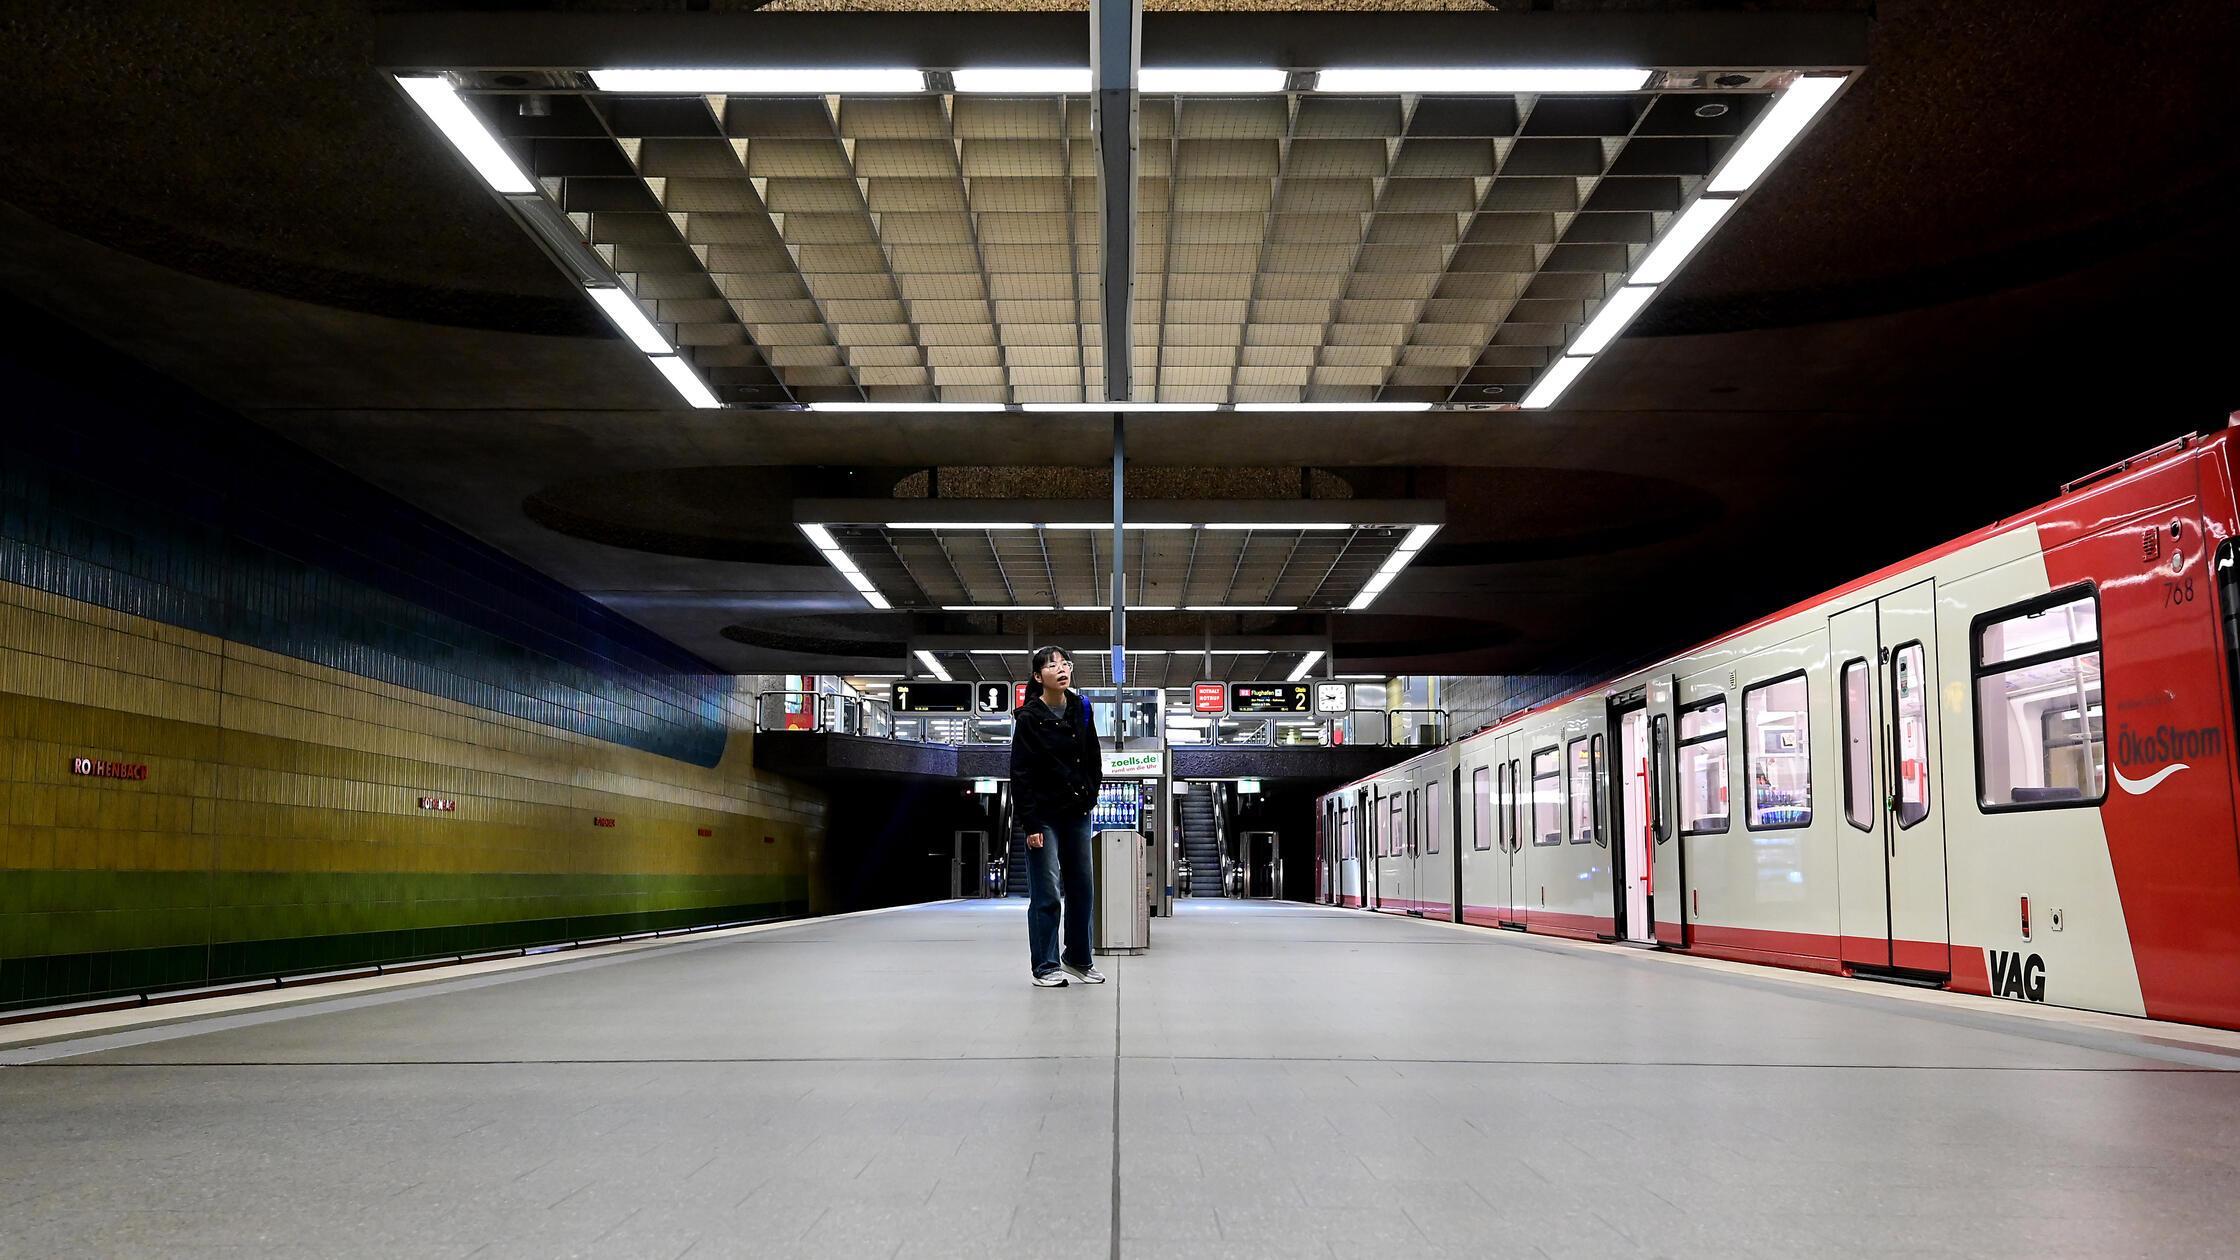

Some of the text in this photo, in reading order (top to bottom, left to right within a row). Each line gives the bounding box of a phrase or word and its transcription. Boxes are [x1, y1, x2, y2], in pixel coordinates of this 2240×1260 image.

[2164, 578, 2194, 608] 768
[898, 692, 906, 710] 1
[1250, 688, 1275, 697] Flughafen
[1295, 693, 1306, 710] 2
[2117, 724, 2222, 767] ÖkoStrom
[1111, 755, 1157, 767] zoells.de
[1989, 949, 2046, 1002] VAG
